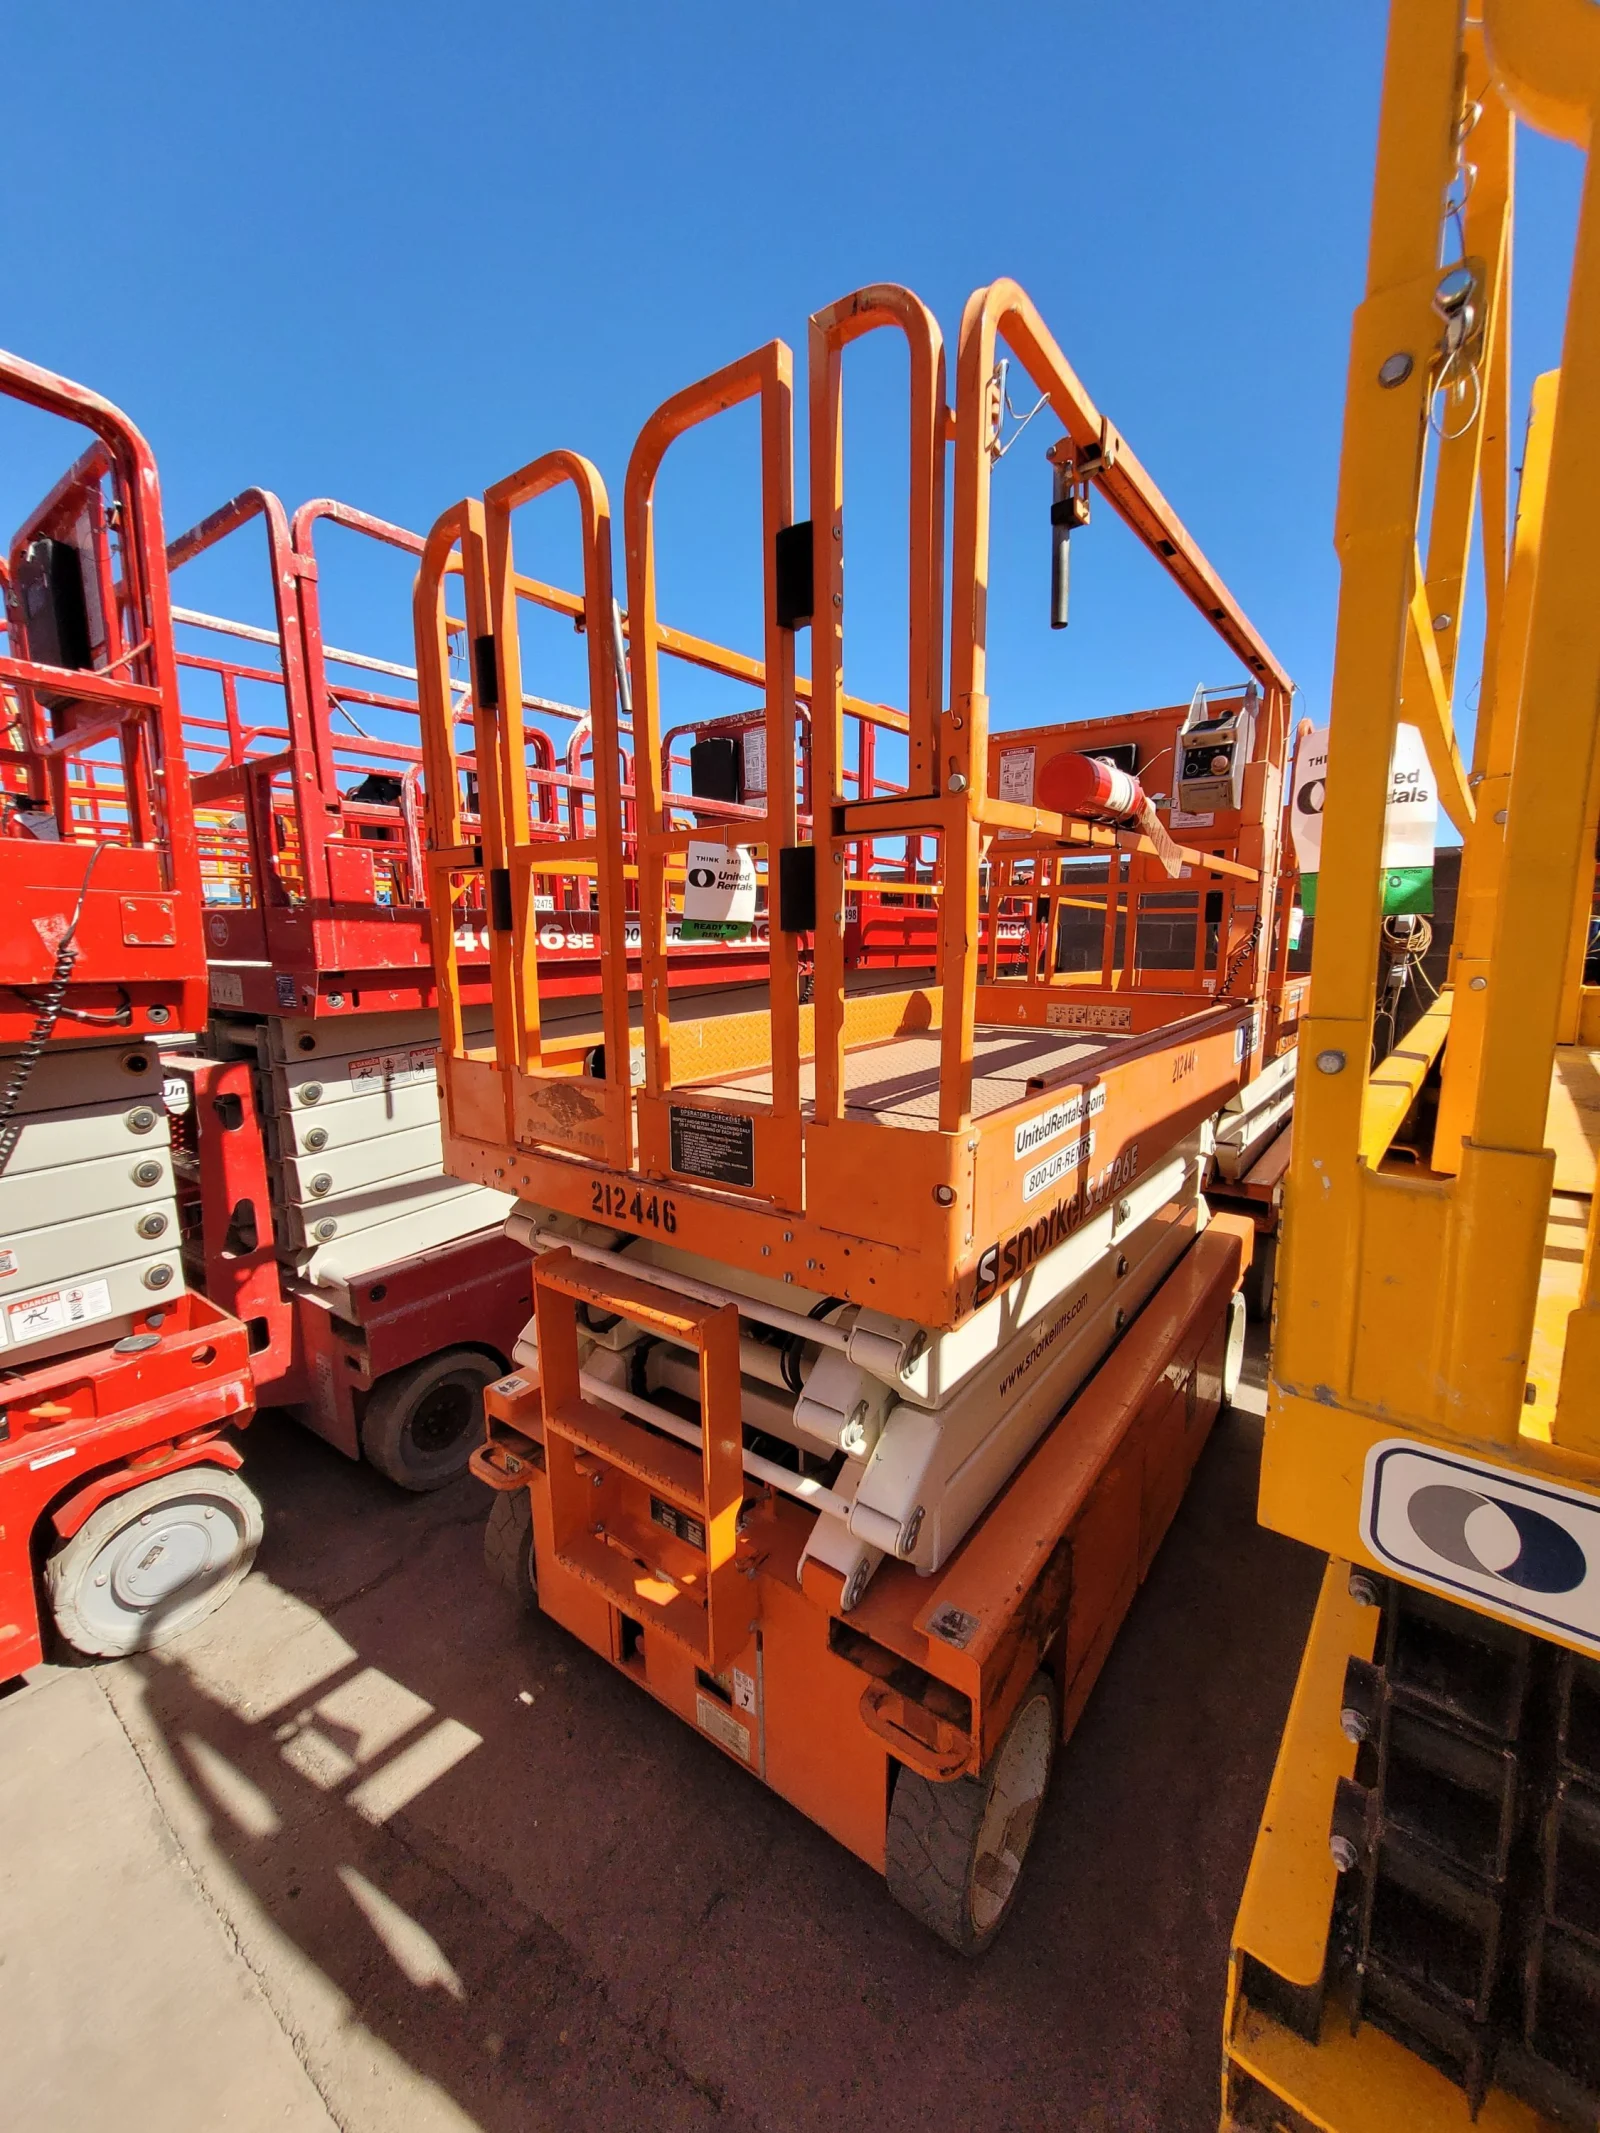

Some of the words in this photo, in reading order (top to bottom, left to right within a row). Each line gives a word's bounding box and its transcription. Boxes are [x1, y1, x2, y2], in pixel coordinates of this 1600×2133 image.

[696, 855, 719, 863] THINK
[718, 870, 751, 881] United
[717, 881, 753, 891] Rentals
[693, 922, 724, 930] READY
[726, 923, 738, 931] TO
[680, 1109, 710, 1119] OPERATORS
[1016, 1092, 1106, 1153] UnitedRentals.com
[1029, 1136, 1091, 1192] 800-UR-RENTS
[591, 1180, 677, 1234] 212446
[1002, 1181, 1086, 1282] snorkel
[21, 1294, 59, 1310] DANGER
